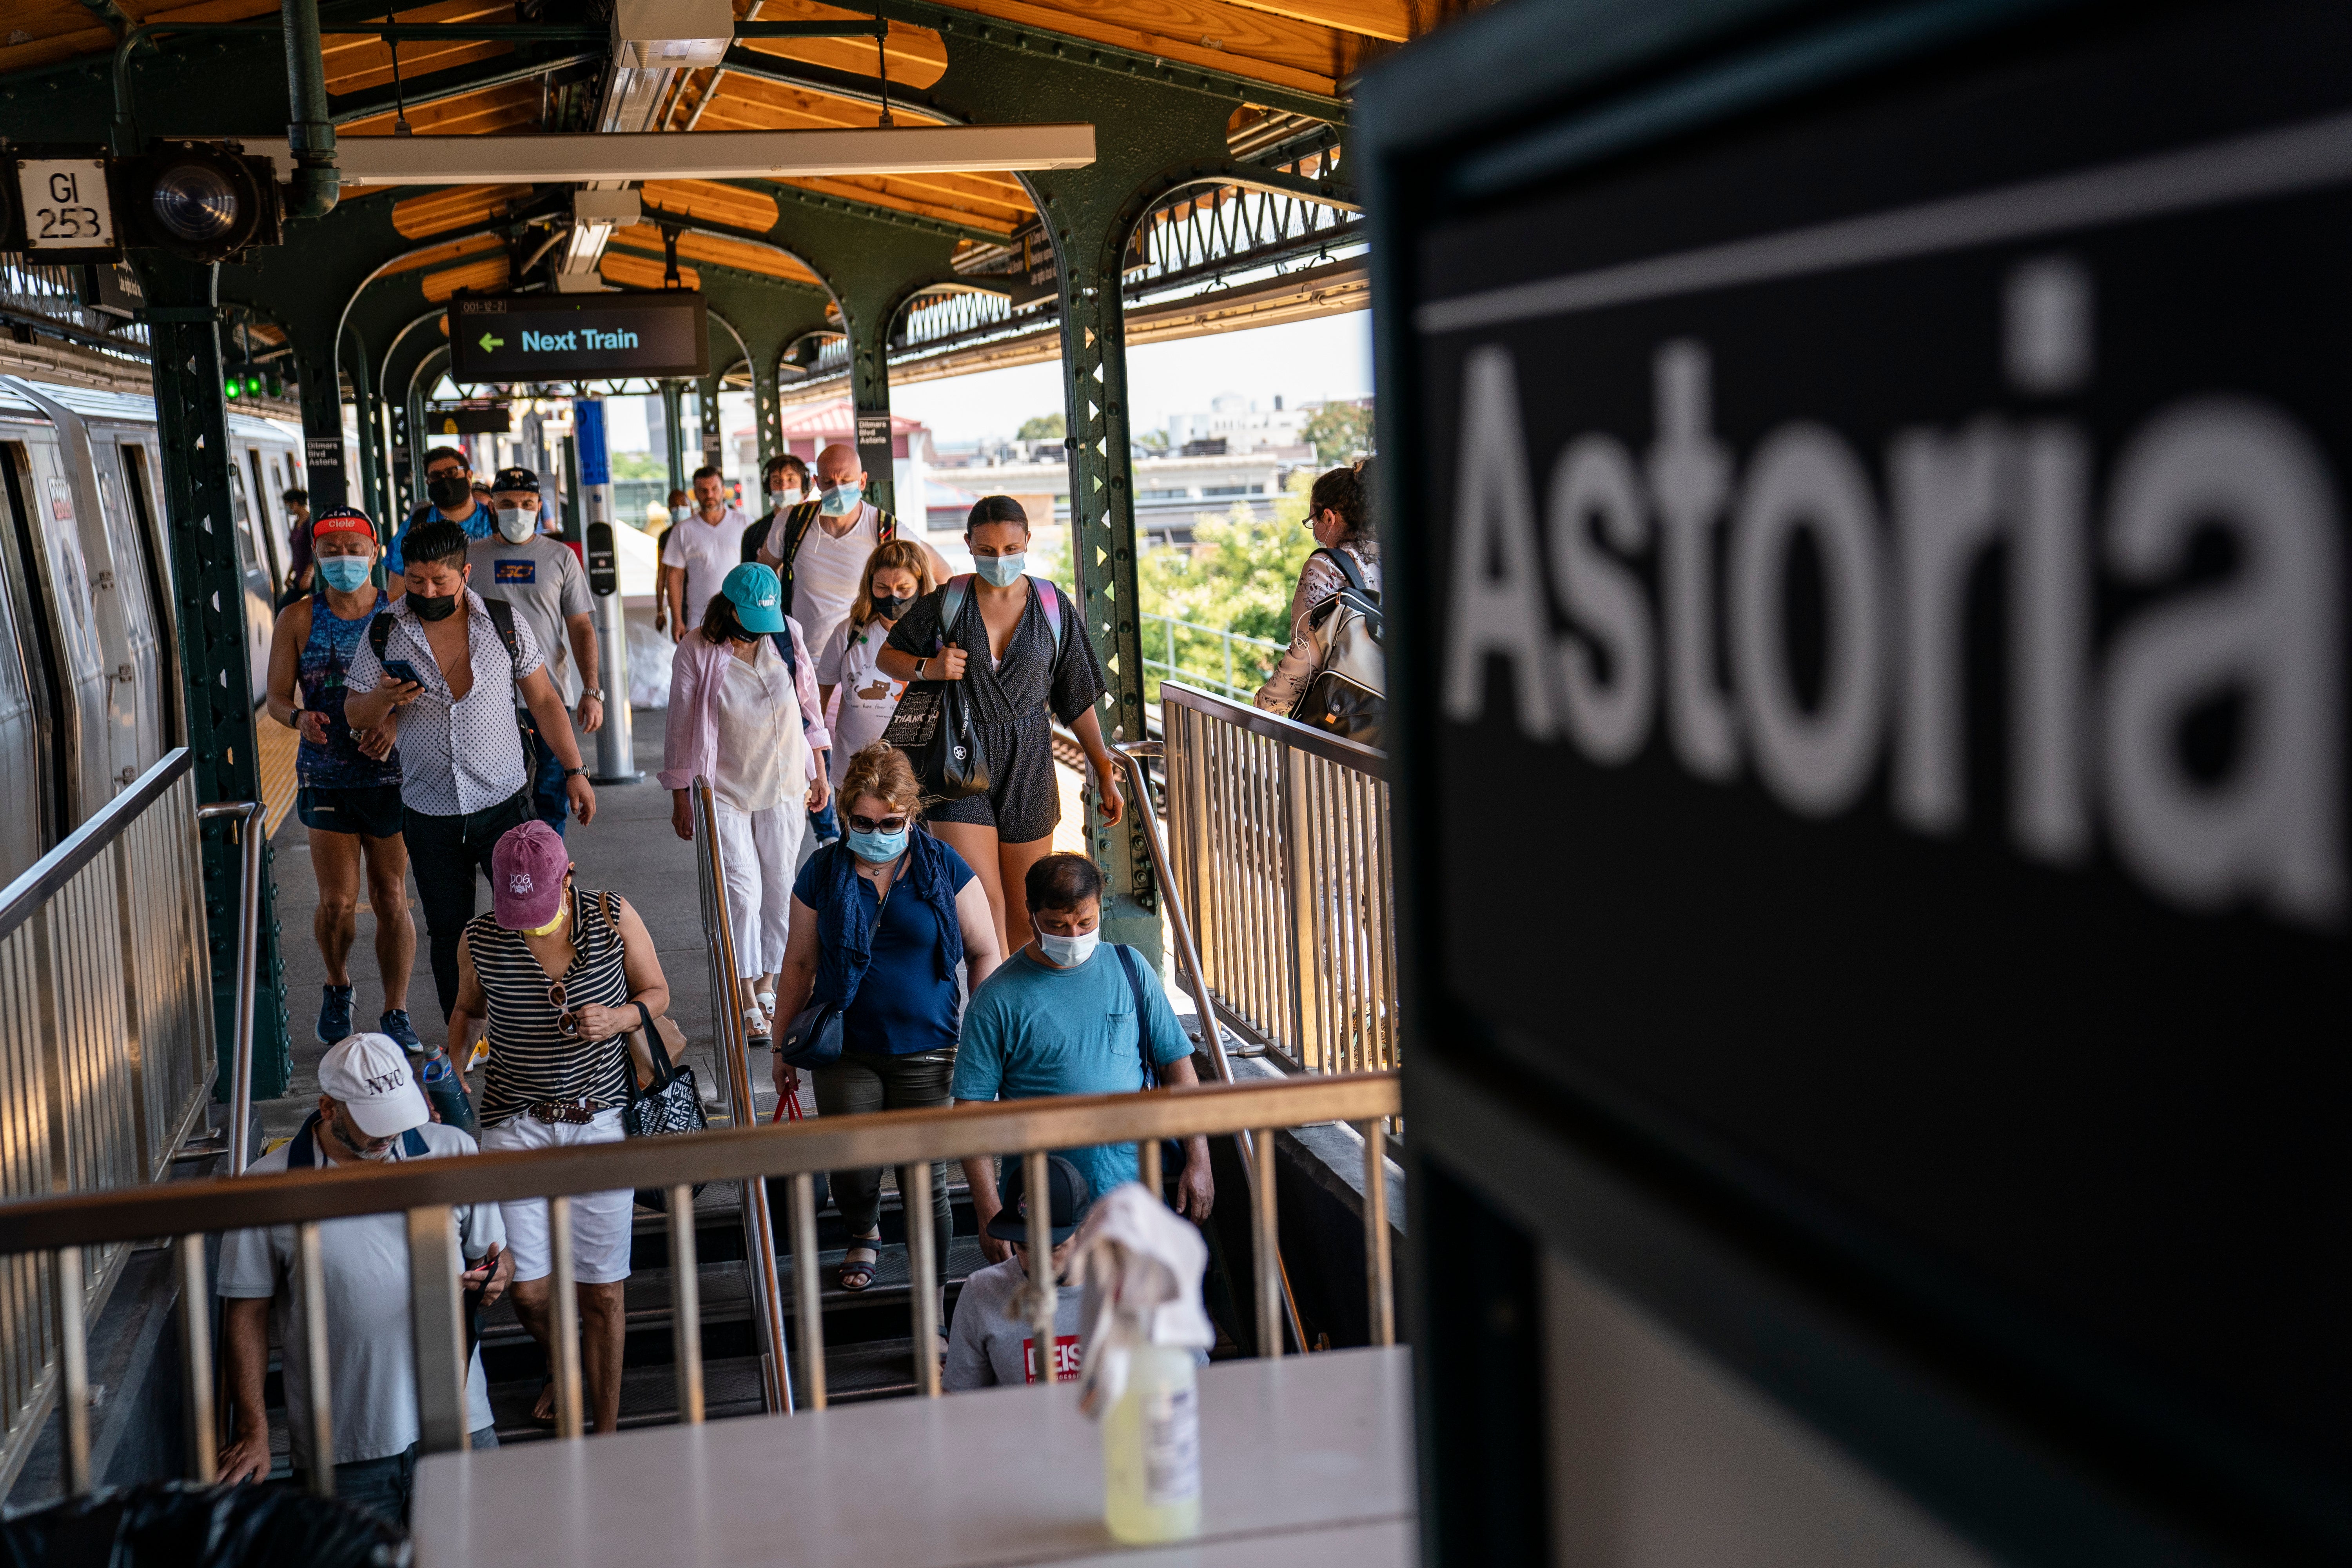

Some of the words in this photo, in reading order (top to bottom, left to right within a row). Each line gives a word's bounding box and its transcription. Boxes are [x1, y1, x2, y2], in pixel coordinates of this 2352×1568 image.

[36, 207, 101, 239] 253
[522, 330, 577, 352] Next
[580, 328, 639, 350] Train
[858, 420, 887, 428] Ditmars
[858, 428, 876, 436] Blvd
[860, 436, 886, 444] Astoria
[307, 441, 338, 450] Ditmars
[308, 450, 325, 458] Blvd
[309, 457, 338, 466] Astoria
[1441, 253, 2349, 928] Astoria
[759, 599, 774, 607] PUMA
[894, 713, 925, 723] THANK
[960, 720, 969, 740] Recycle.
[509, 874, 530, 884] DOG
[365, 1068, 404, 1096] NYC
